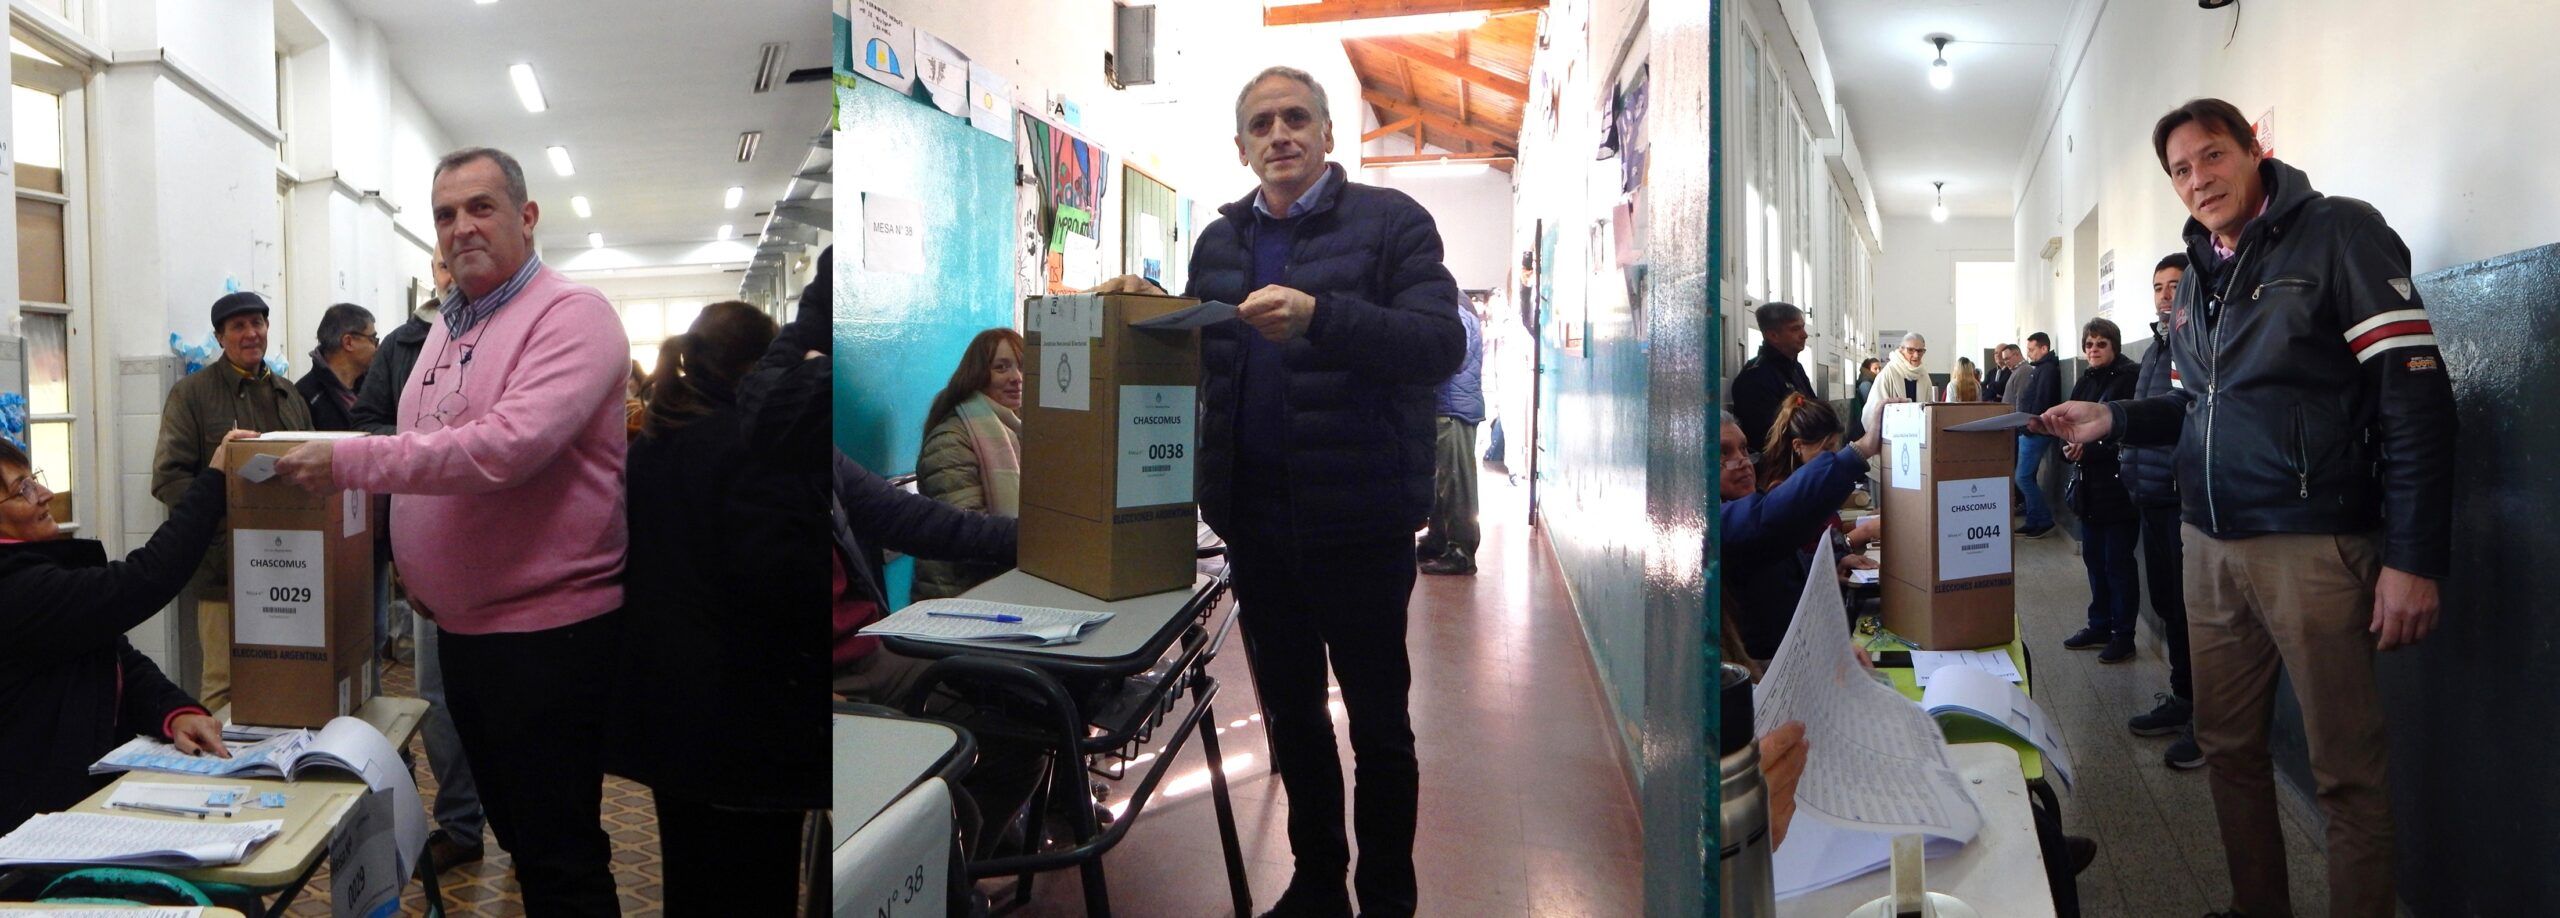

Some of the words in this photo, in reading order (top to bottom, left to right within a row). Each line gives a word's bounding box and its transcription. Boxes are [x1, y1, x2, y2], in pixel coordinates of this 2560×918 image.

[873, 221, 895, 234] MESA
[904, 226, 913, 237] 38
[1133, 415, 1181, 425] CHASCOMUS
[1148, 443, 1184, 460] 0038
[1951, 502, 1997, 513] CHASCOMUS
[1967, 524, 2001, 540] 0044
[250, 559, 307, 569] CHASCOMUS
[269, 586, 312, 603] 0029
[1934, 582, 1973, 593] ELECCIONES
[232, 648, 278, 660] ELECCIONES
[279, 650, 328, 662] ARGENTINAS
[348, 865, 366, 909] 0029
[904, 864, 924, 904] 38
